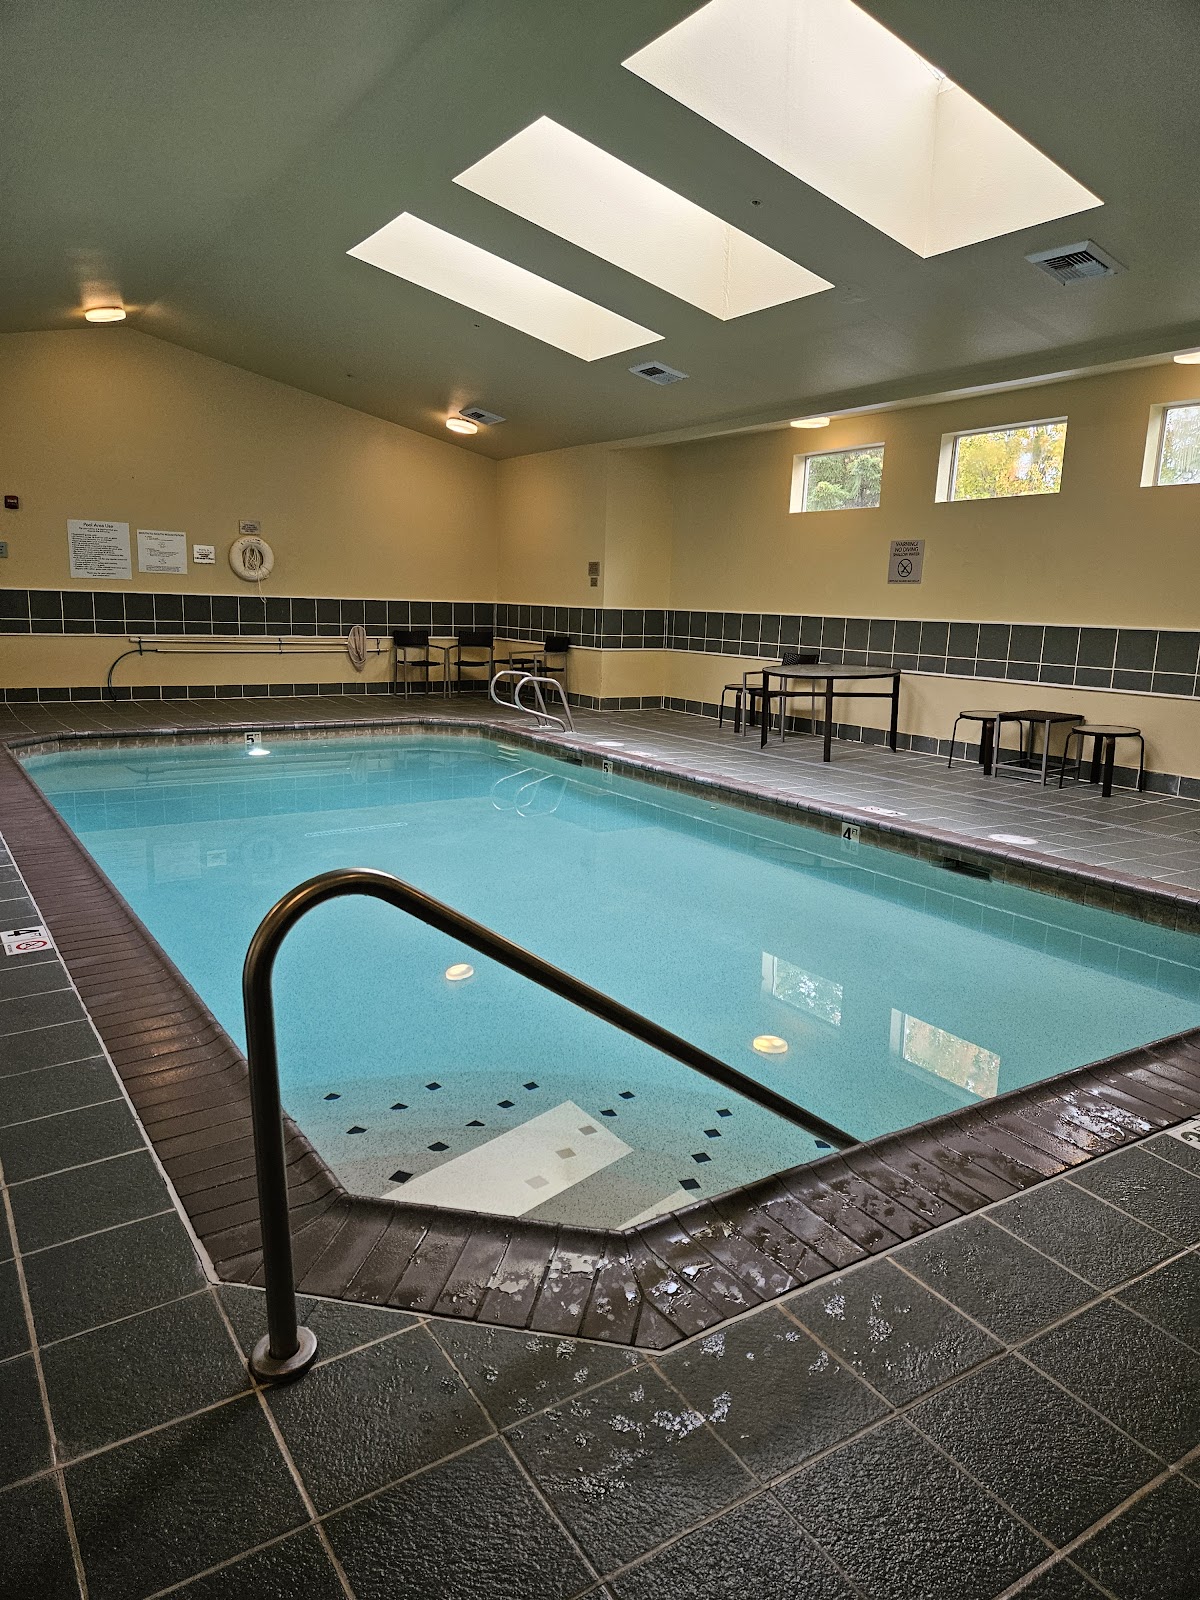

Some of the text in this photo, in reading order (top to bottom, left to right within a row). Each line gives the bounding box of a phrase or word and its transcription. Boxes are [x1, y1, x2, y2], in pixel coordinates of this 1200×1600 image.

[246, 734, 254, 744] 5
[603, 762, 609, 773] 5
[843, 827, 852, 840] 4
[7, 929, 40, 937] 4
